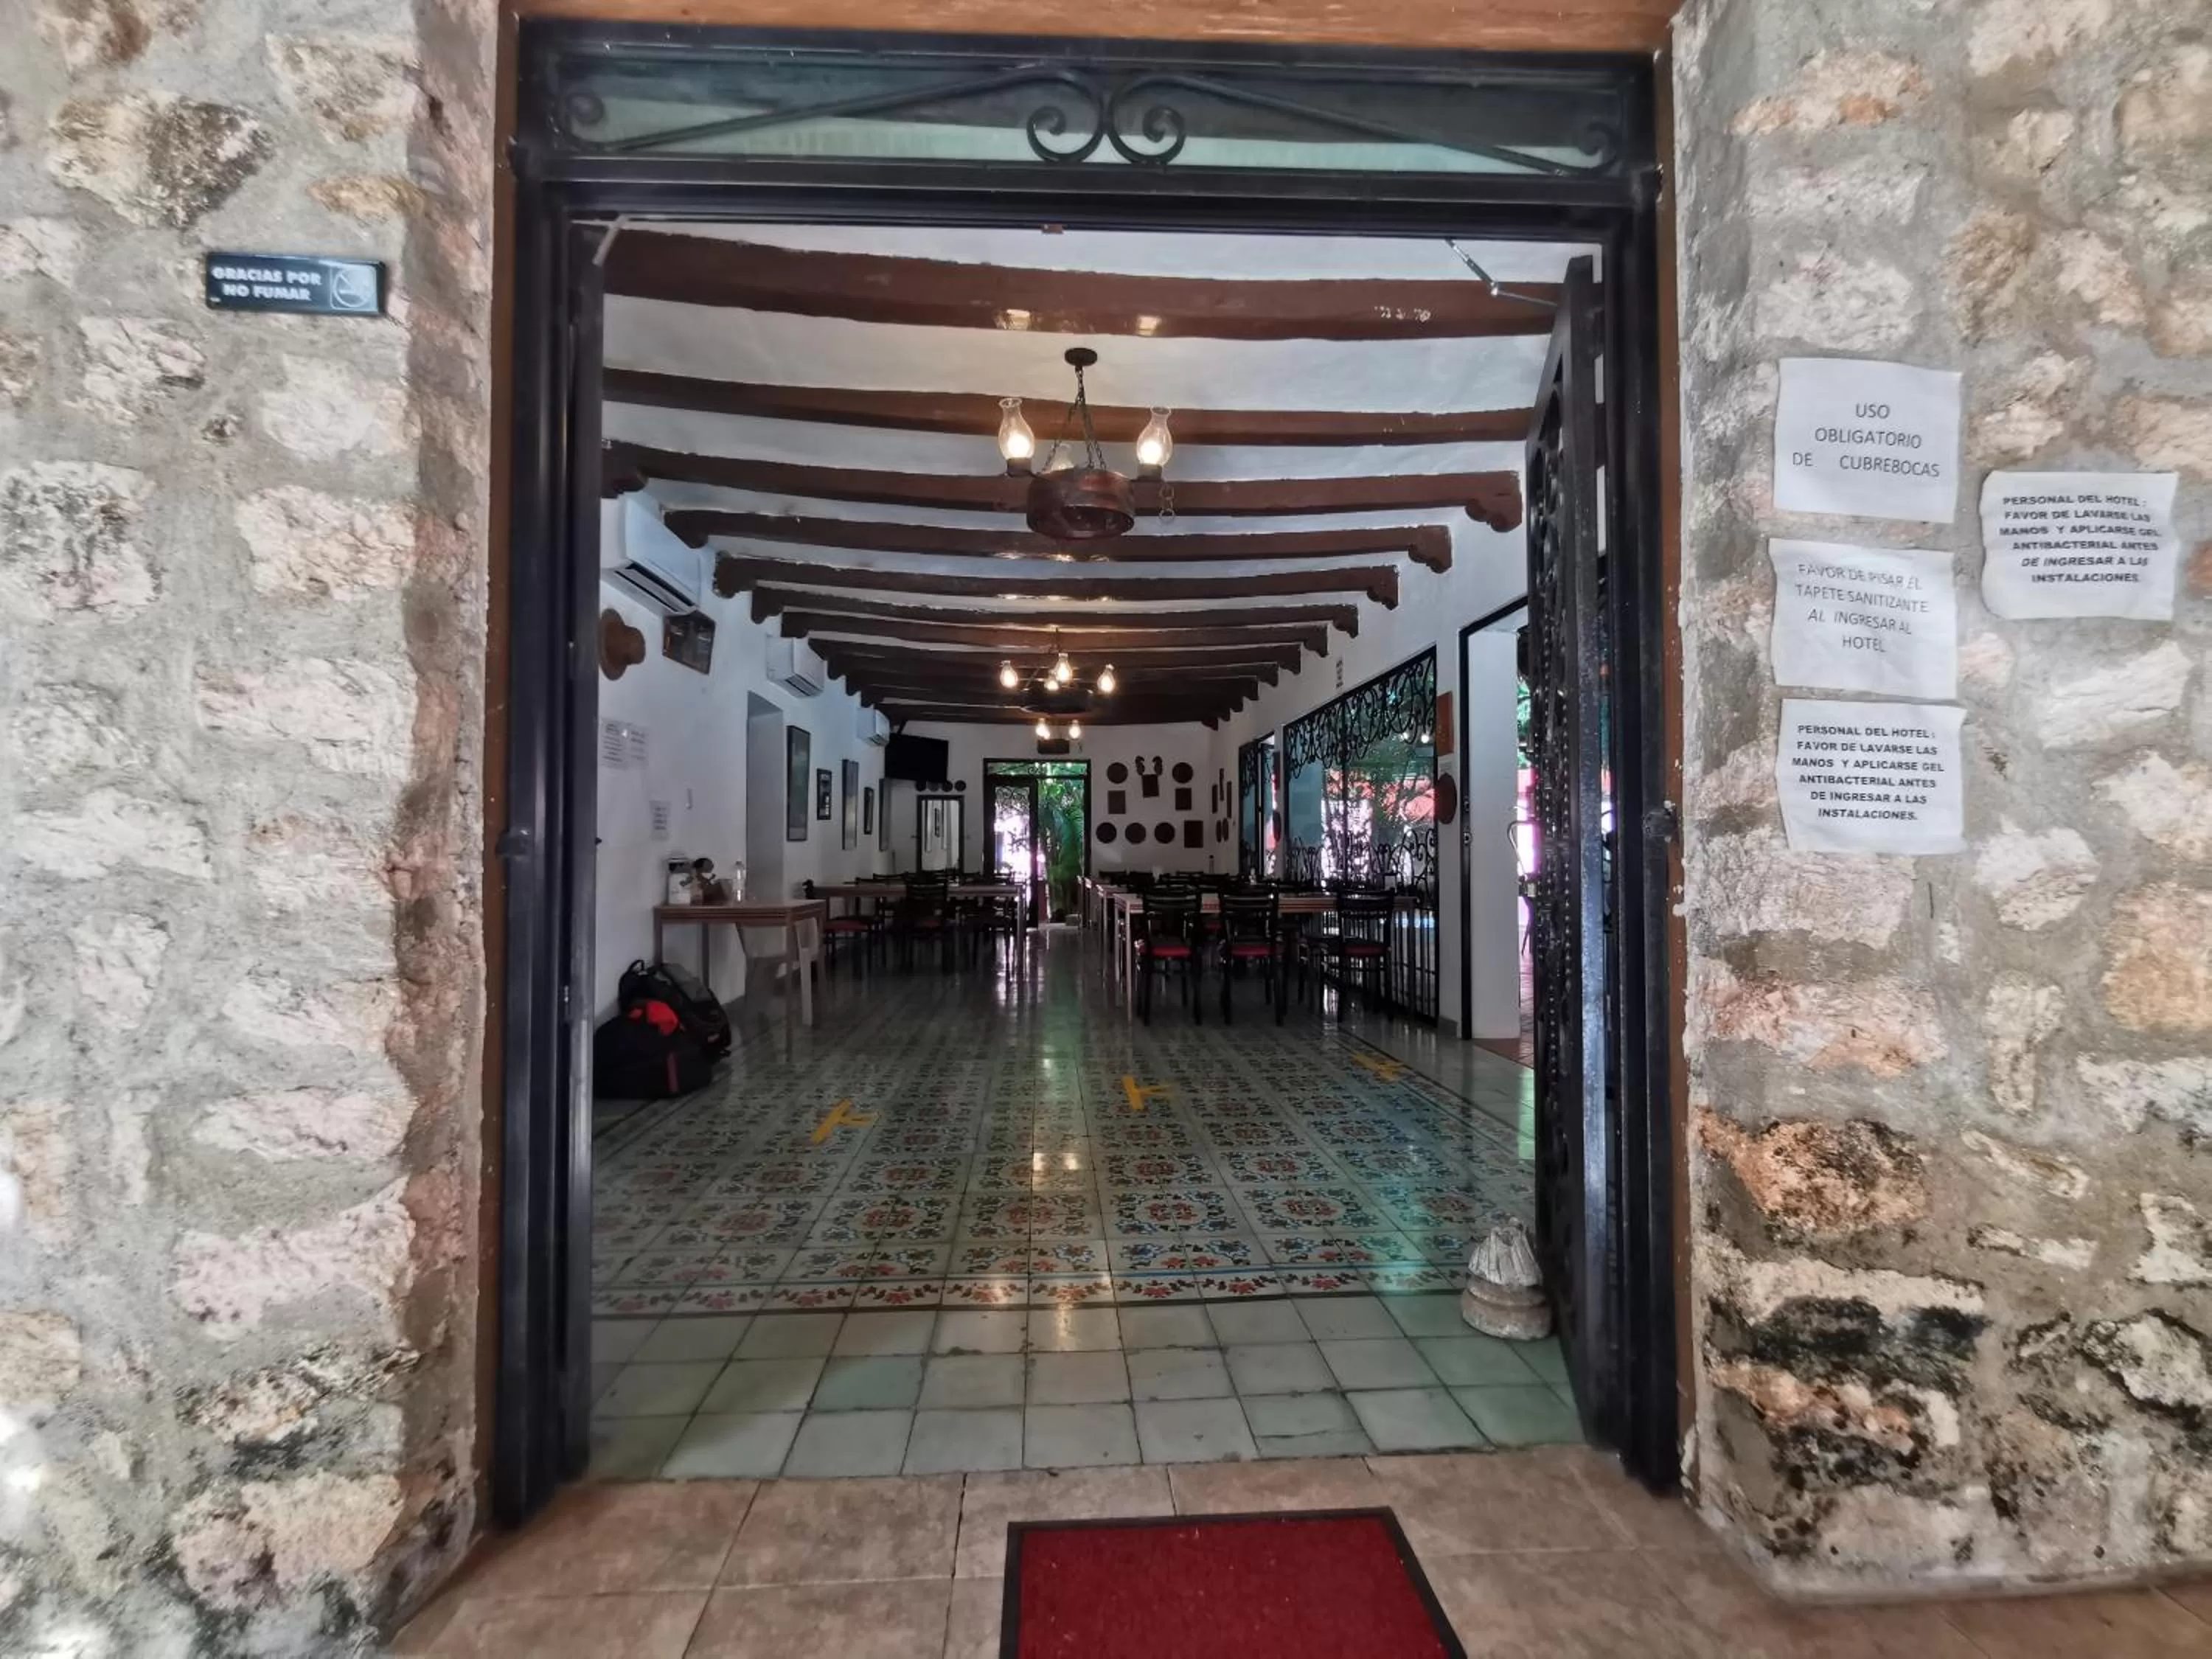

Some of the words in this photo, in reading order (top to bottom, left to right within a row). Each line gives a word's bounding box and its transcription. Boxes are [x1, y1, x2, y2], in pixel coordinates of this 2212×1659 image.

[212, 267, 282, 282] GRACIAS
[286, 271, 321, 285] POR
[222, 283, 249, 297] NO
[253, 285, 311, 301] FUMAR
[1856, 403, 1891, 419] USO
[1815, 428, 1921, 449] OBLIGATORIO
[1792, 452, 1813, 467] DE
[1840, 455, 1940, 477] CUBREBOCAS
[2003, 495, 2073, 505] PERSONAL
[2077, 495, 2101, 504] DEL
[2005, 511, 2048, 520] FAVOR
[2052, 510, 2070, 519] DE
[2074, 510, 2127, 520] LAVARSE
[2129, 512, 2150, 522] LAS
[1999, 526, 2048, 535] MANOS
[2056, 526, 2065, 534] Y
[2070, 525, 2135, 536] APLICARSE
[2138, 529, 2162, 537] GEL
[2013, 540, 2117, 549] ANTIBACTERIAL
[2121, 542, 2159, 551] ANTES
[2021, 558, 2039, 567] DE
[2043, 557, 2114, 566] INGRESAR
[2117, 557, 2126, 565] A
[2129, 557, 2149, 566] LAS
[1797, 564, 1846, 579] FAVOR
[1848, 568, 1865, 580] DE
[1868, 571, 1903, 585] PISAR
[1907, 577, 1922, 591] EL
[1795, 584, 1843, 601] TAPETE
[1847, 591, 1929, 613] SANITIZANTE
[1807, 608, 1826, 622] AL
[1834, 611, 1896, 631] INGRESAR
[1899, 621, 1912, 635] AL
[1843, 636, 1886, 653] HOTEL
[1798, 725, 1861, 736] PERSONAL
[1865, 728, 1888, 737] DEL
[1797, 741, 1837, 751] FAVOR
[1840, 742, 1856, 751] DE
[1860, 743, 1913, 754] LAVARSE
[1916, 745, 1938, 755] LAS
[1792, 758, 1834, 768] MANOS
[1841, 759, 1849, 768] Y
[1853, 759, 1918, 771] APLICARSE
[1922, 762, 1945, 772] GEL
[1798, 775, 1895, 786] ANTIBACTERIAL
[1899, 779, 1936, 788] ANTES
[1810, 791, 1826, 800] DE
[1830, 792, 1891, 802] INGRESAR
[1894, 795, 1902, 803] A
[1905, 795, 1927, 804] LAS
